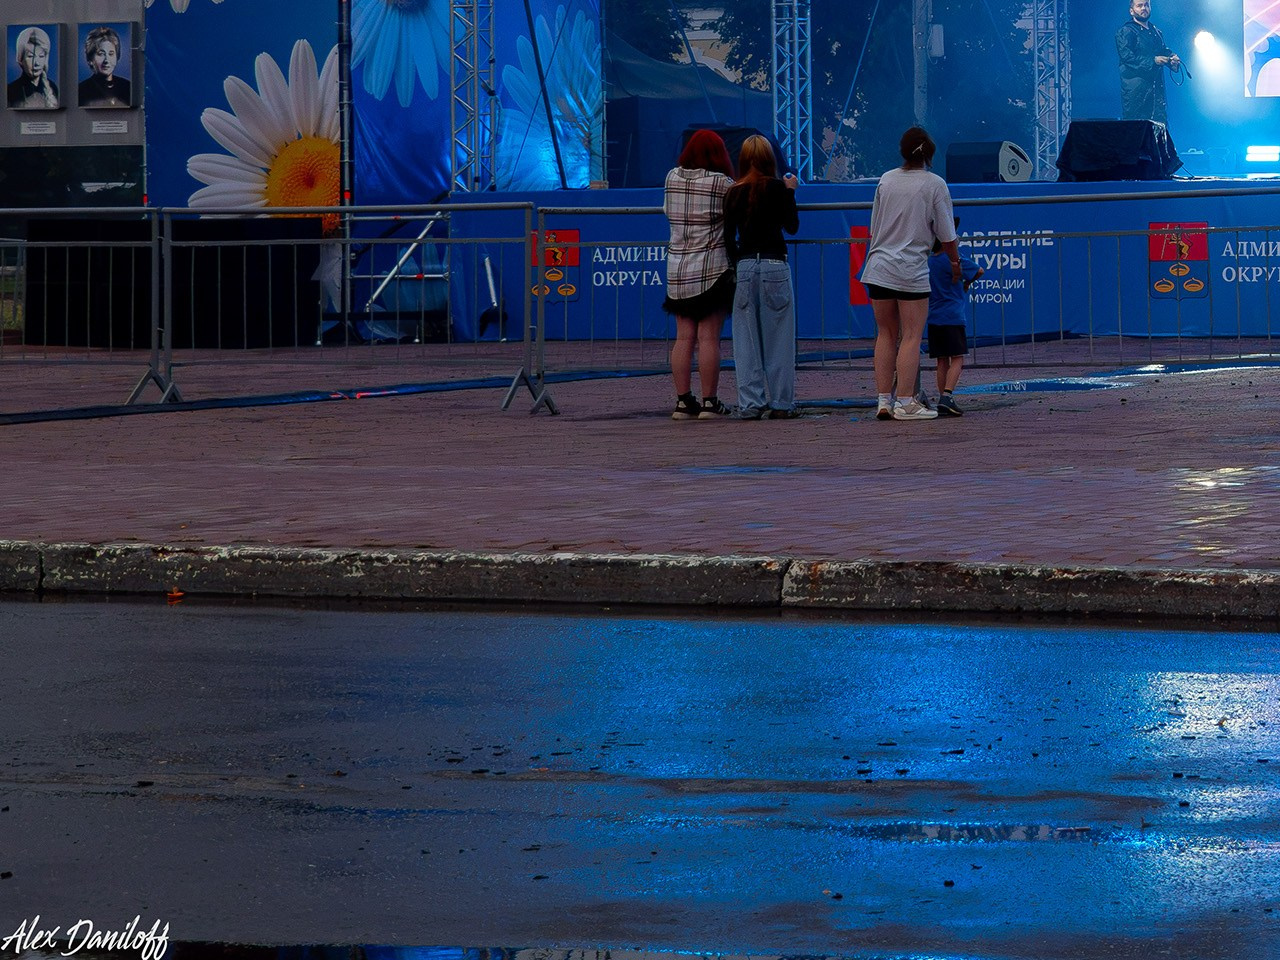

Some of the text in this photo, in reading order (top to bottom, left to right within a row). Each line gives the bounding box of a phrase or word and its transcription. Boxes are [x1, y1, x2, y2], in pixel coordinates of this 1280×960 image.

[957, 229, 1055, 248] АВЛЕНИЕ
[970, 253, 1027, 270] ТУРЫ
[592, 270, 663, 287] ОКРУГА
[968, 293, 1013, 304] МУРОМ
